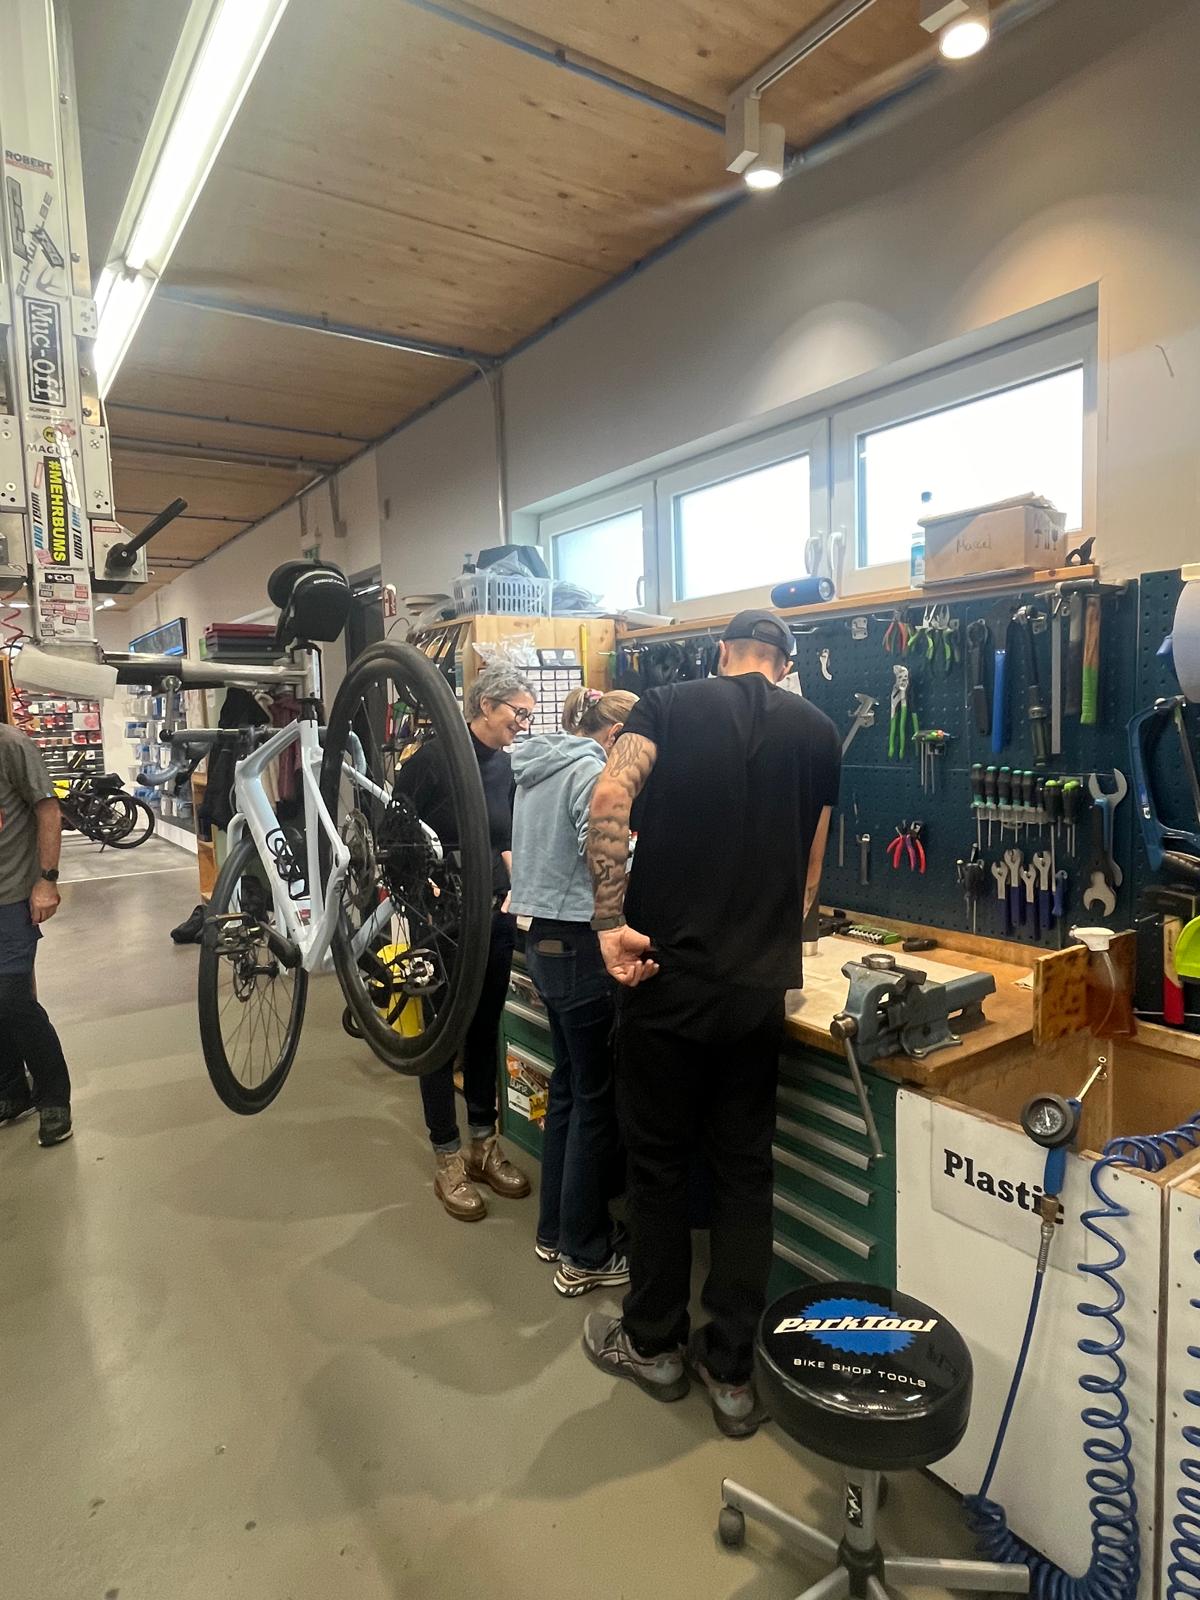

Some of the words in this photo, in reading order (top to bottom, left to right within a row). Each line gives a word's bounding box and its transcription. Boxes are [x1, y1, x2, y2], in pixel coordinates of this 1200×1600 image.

[5, 149, 52, 170] ROBERT
[31, 304, 60, 400] Muc-Off
[26, 443, 80, 458] MAGUA
[48, 460, 66, 562] #MEHRBUMS
[773, 1316, 938, 1334] ParkTool
[793, 1358, 825, 1369] BIKE
[832, 1363, 872, 1375] SHOP
[877, 1370, 927, 1388] TOOLS
